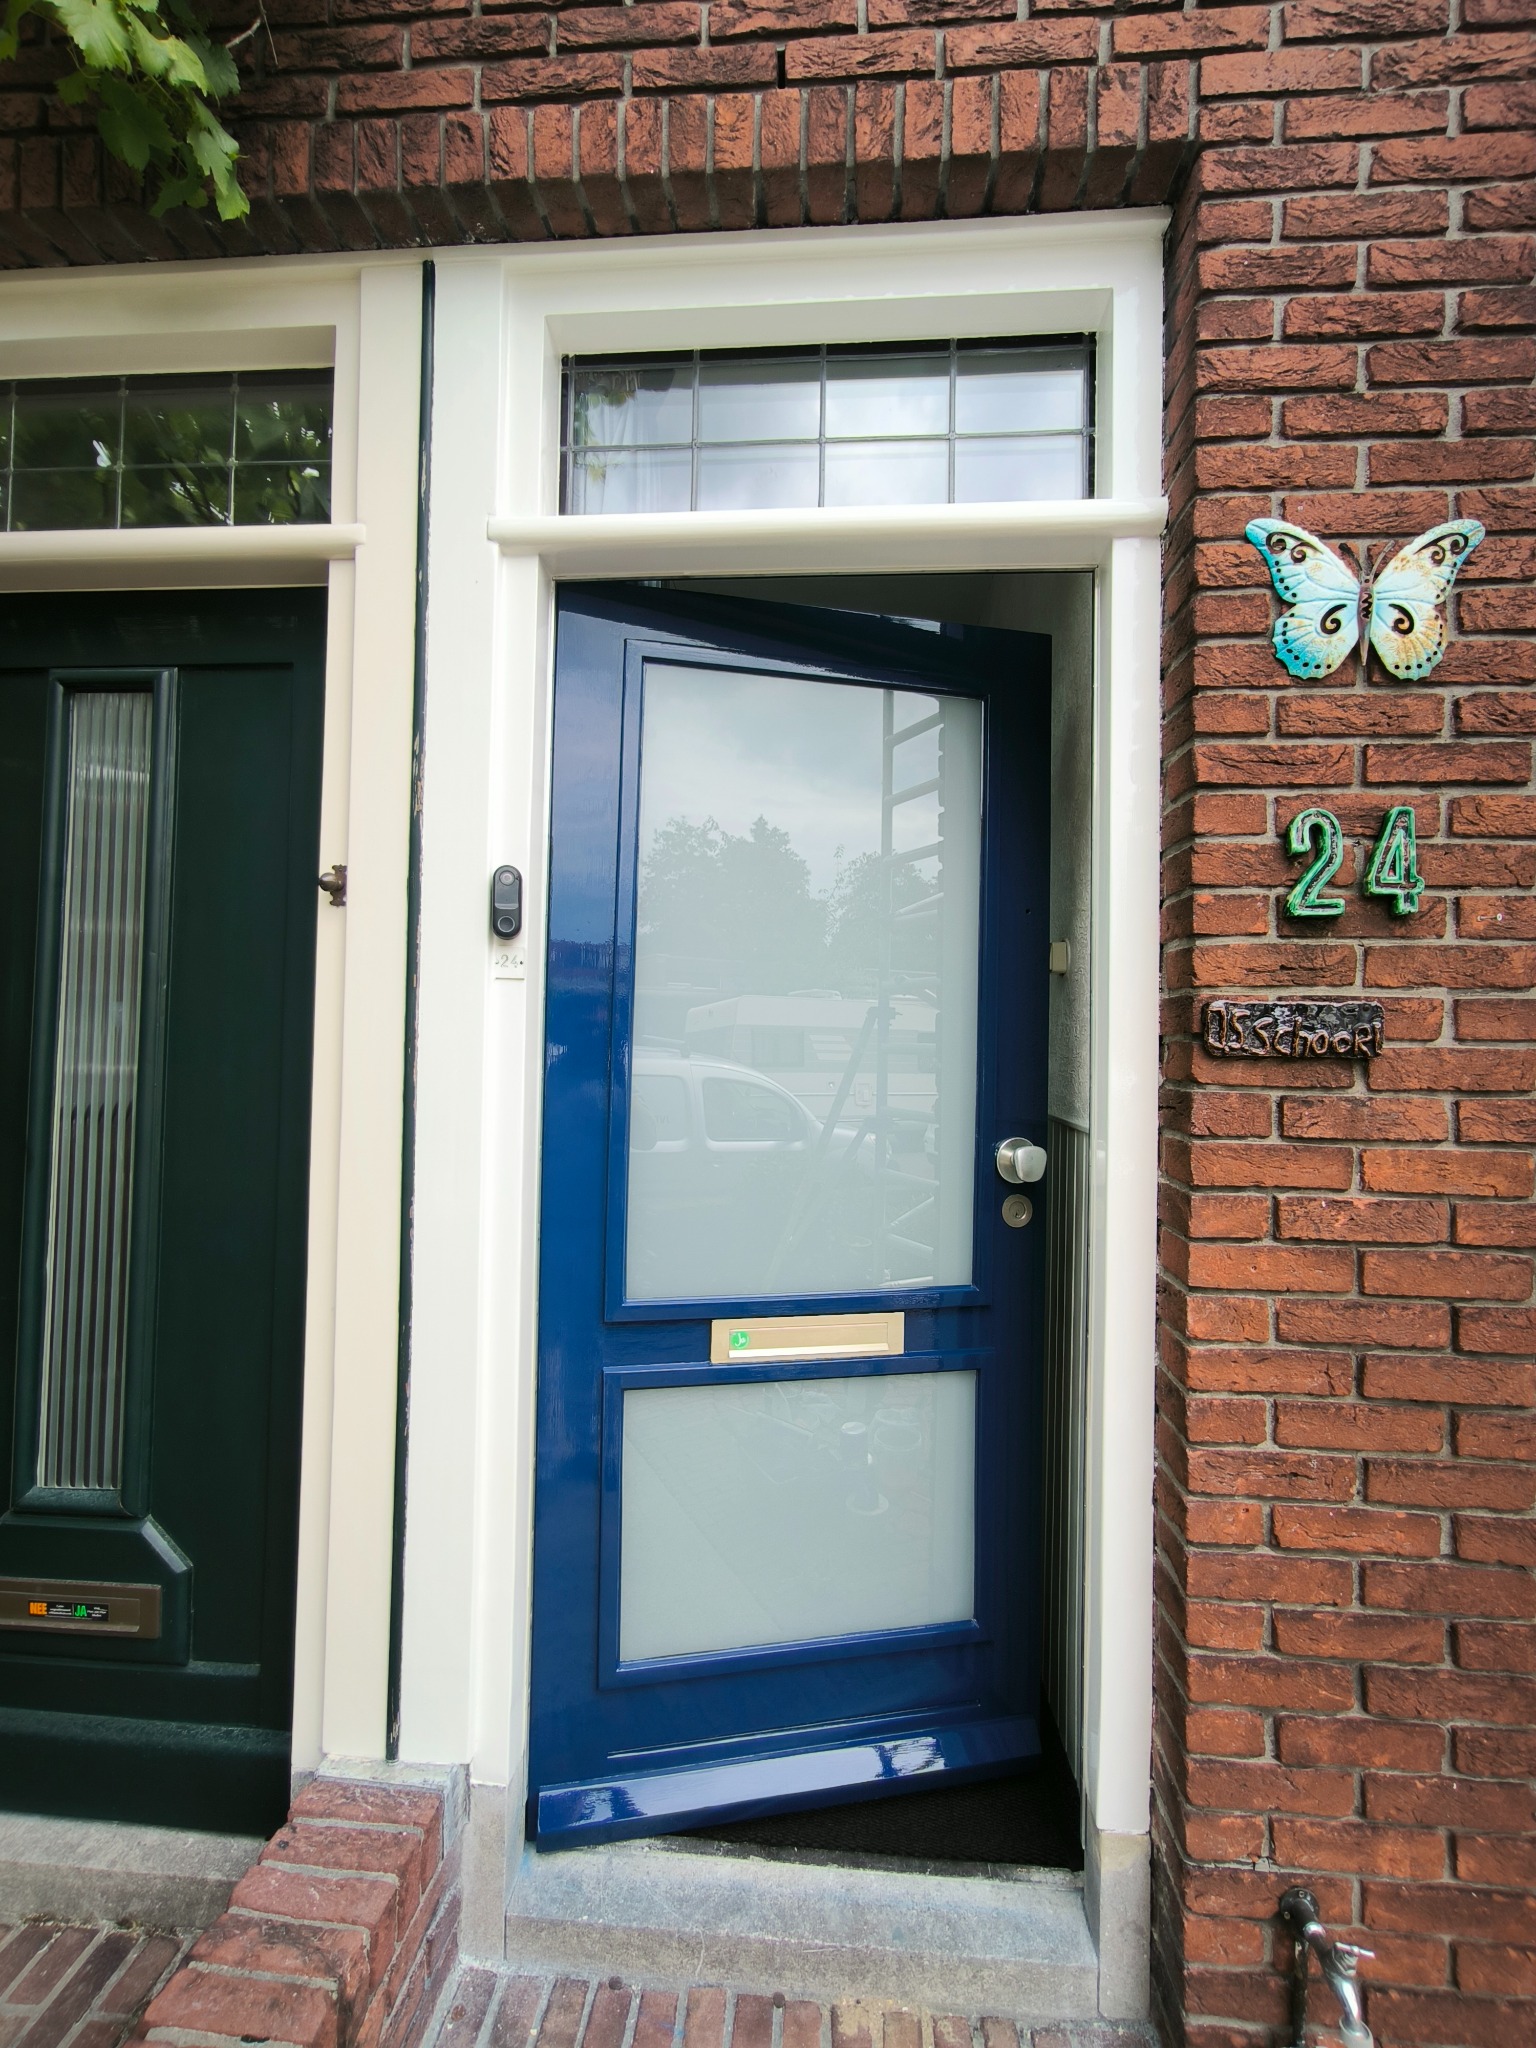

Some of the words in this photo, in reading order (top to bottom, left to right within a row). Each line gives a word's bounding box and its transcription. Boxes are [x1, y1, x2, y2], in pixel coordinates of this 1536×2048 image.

[1284, 806, 1426, 918] 24
[29, 1602, 47, 1615] NEE
[75, 1605, 88, 1617] JA
